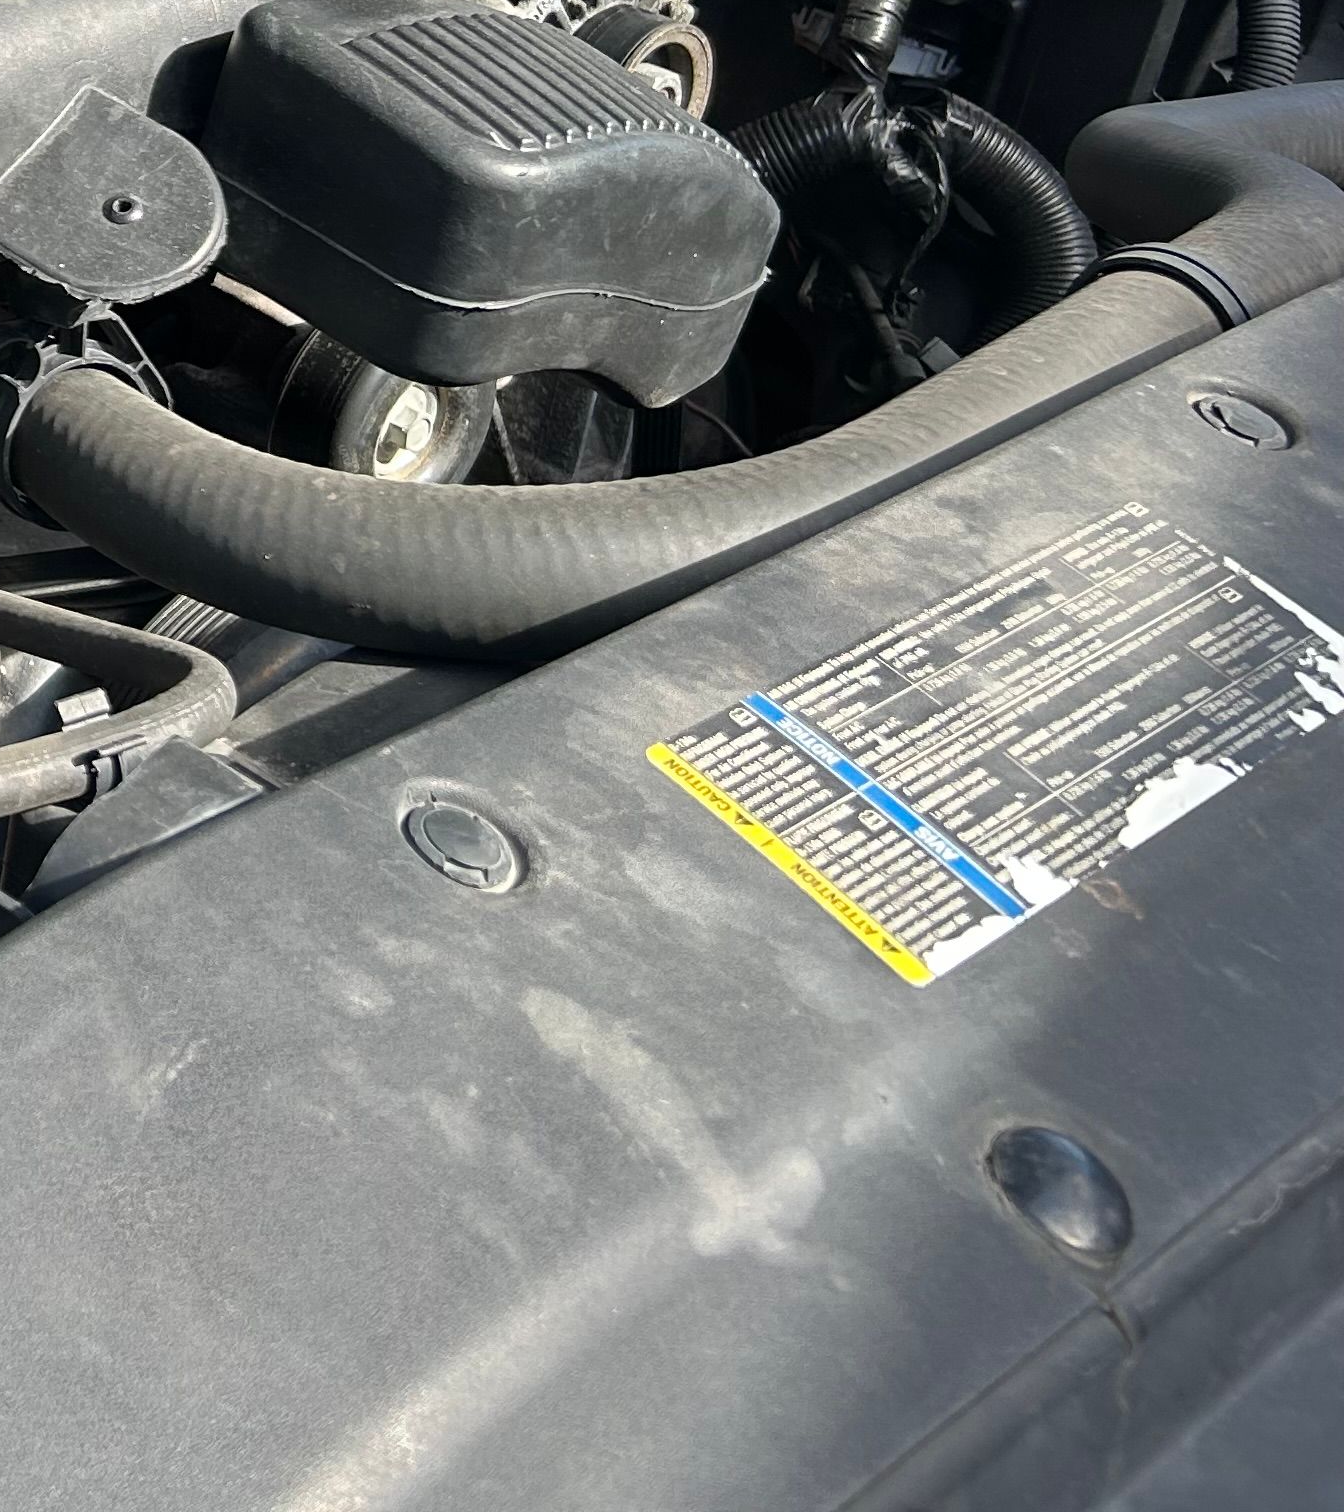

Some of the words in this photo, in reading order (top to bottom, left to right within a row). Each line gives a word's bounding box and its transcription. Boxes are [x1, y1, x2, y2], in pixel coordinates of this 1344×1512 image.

[777, 716, 841, 764] NOTICE
[663, 758, 731, 812] CAUTION
[914, 826, 960, 861] AVIS
[790, 863, 878, 936] ATTENTION
